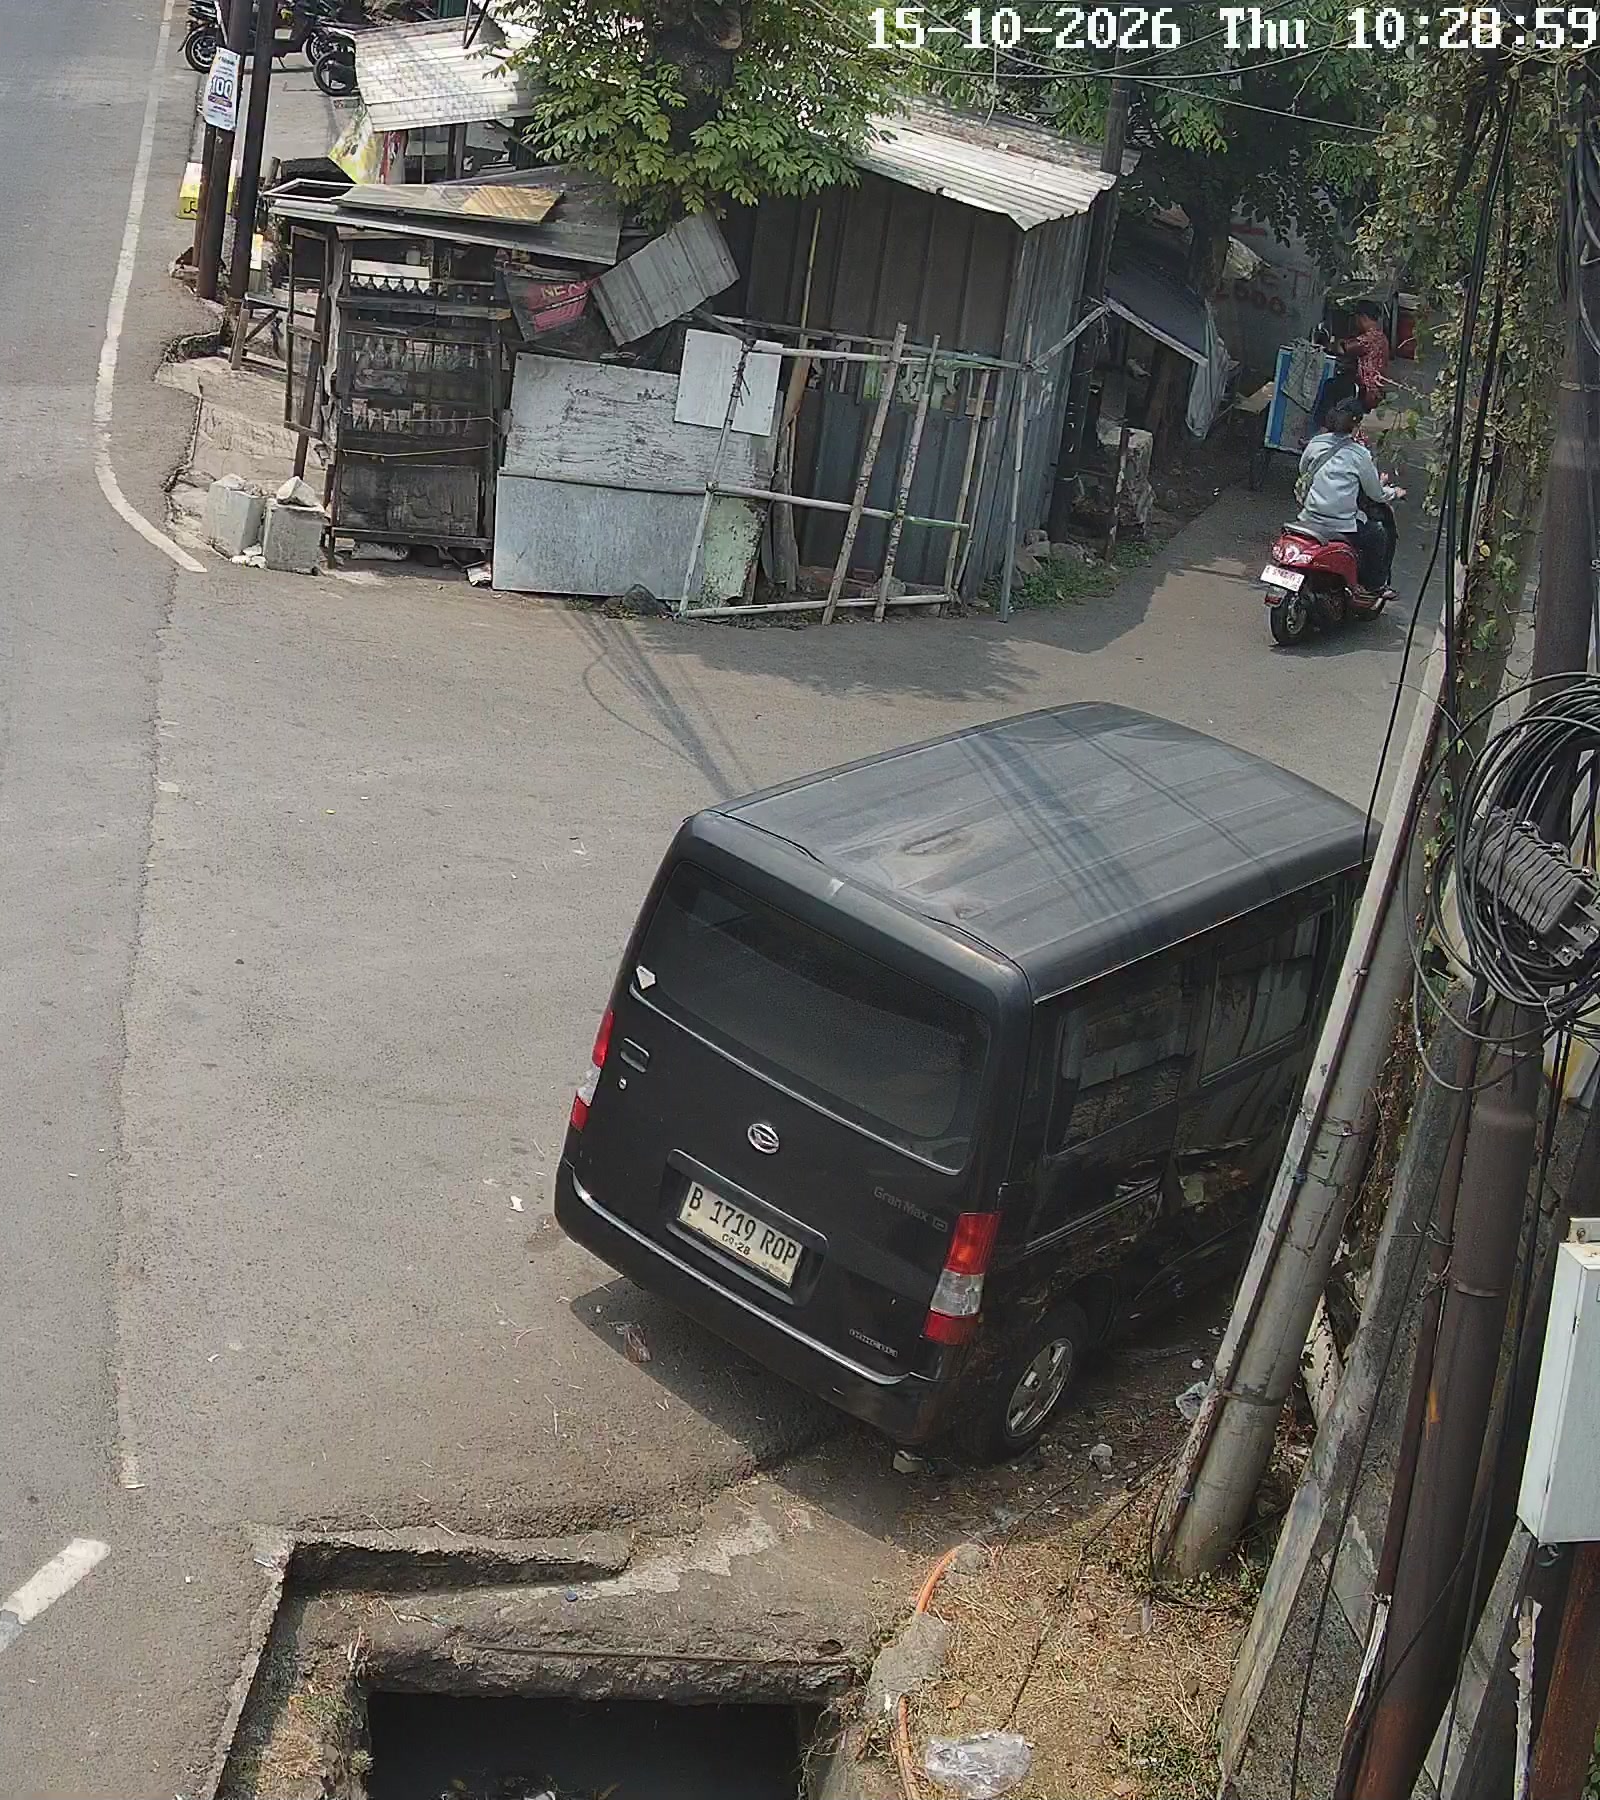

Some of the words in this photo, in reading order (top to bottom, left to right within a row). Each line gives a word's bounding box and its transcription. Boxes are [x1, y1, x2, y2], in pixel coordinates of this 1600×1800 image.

[210, 75, 233, 98] 100
[689, 1186, 703, 1210] B
[709, 1200, 756, 1241] 1719
[760, 1229, 797, 1264] ROP
